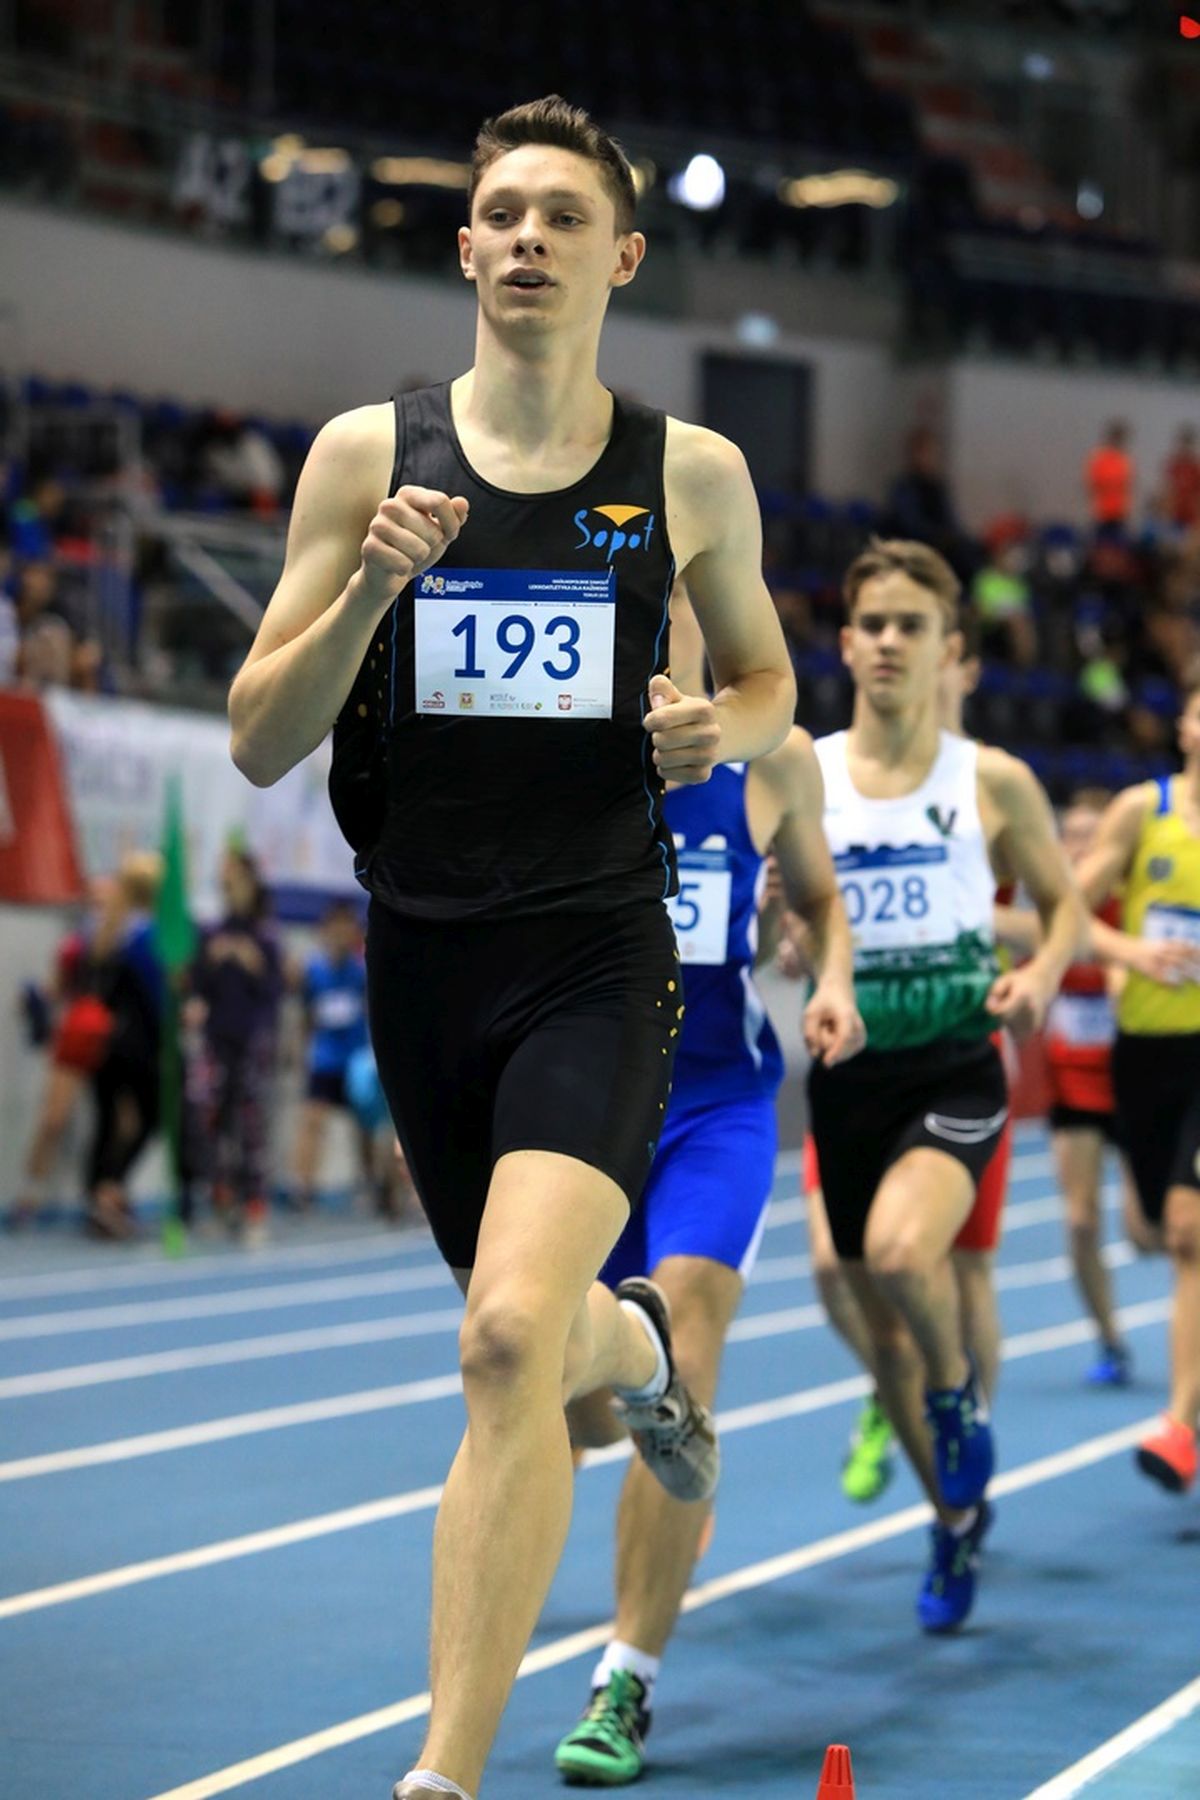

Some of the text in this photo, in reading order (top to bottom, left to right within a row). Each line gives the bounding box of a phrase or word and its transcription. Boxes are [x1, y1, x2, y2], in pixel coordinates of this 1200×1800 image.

[574, 509, 655, 563] Sopot
[452, 614, 581, 681] 193
[840, 876, 929, 926] 028
